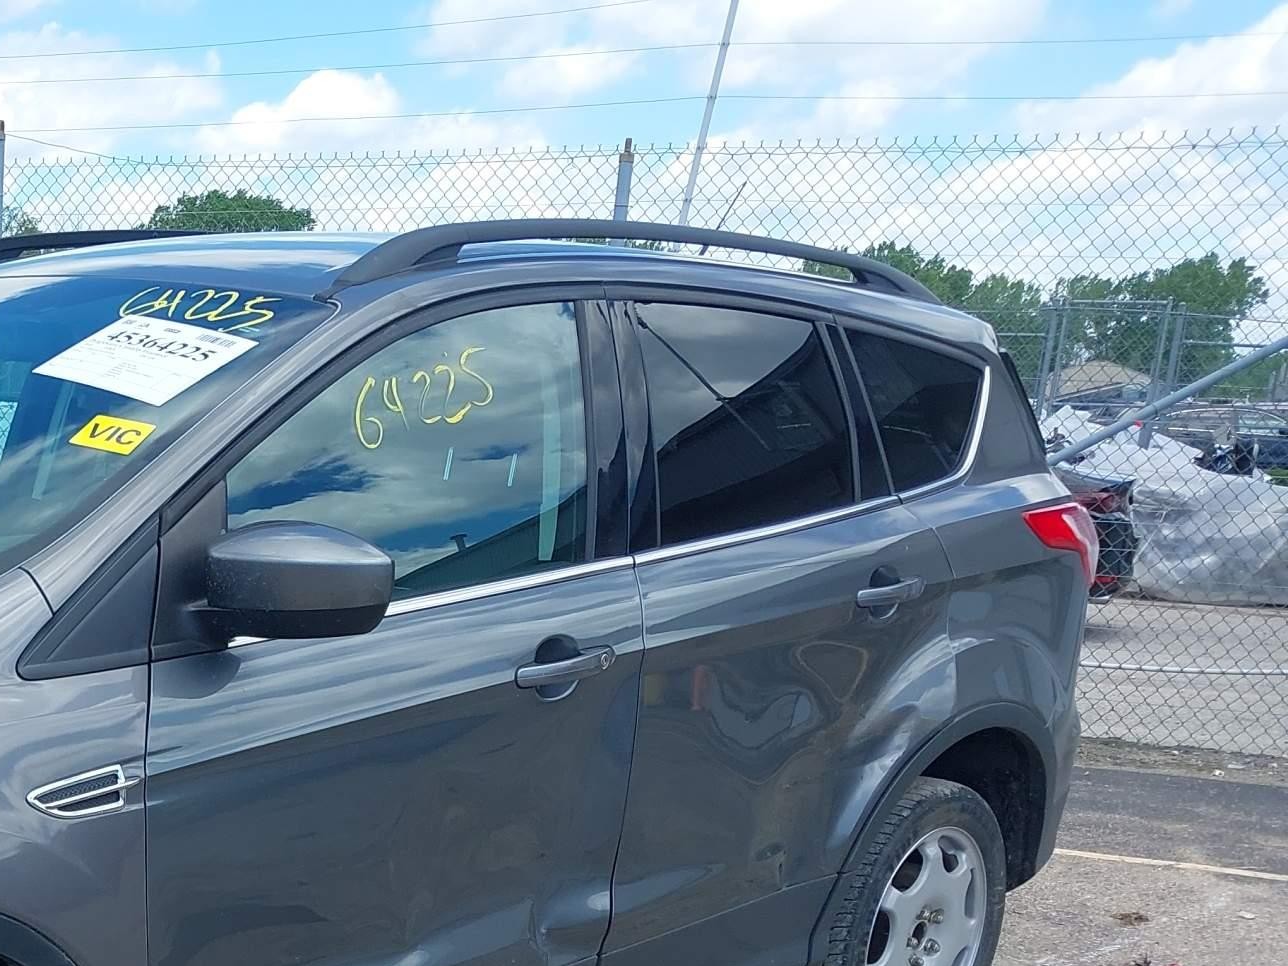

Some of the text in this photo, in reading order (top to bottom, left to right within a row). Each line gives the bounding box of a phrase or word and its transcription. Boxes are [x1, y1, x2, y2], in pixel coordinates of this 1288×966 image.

[108, 331, 217, 362] 45364225
[354, 345, 494, 449] 64225
[89, 422, 142, 445] VIC
